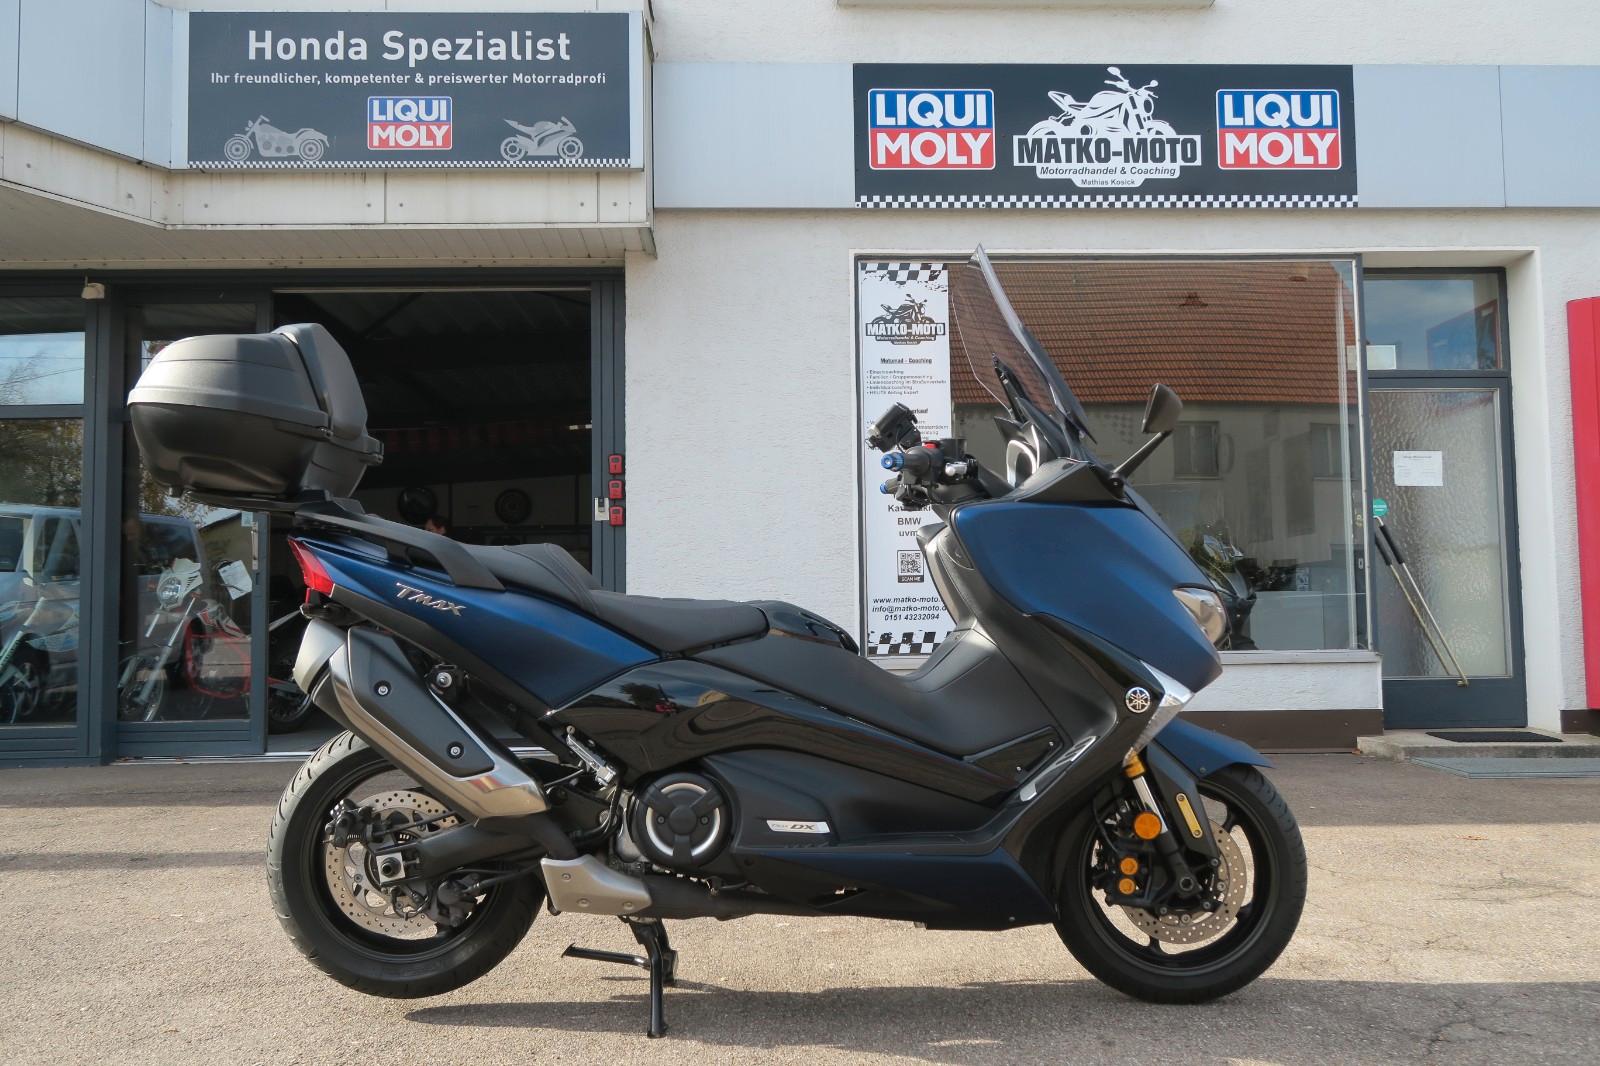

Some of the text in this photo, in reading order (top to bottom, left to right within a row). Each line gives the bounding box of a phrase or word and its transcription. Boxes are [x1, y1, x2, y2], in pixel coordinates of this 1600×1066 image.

[248, 30, 571, 67] Honda Spezialist
[211, 72, 606, 86] Ihr freundlicher, kompetenter & preiswerter Motorradprofi
[372, 99, 447, 123] LIQUI
[876, 93, 987, 129] LIQUI
[1224, 93, 1339, 129] LIQUI
[372, 125, 449, 147] MOLY
[877, 132, 991, 165] MOLY
[1017, 137, 1198, 165] MATKO-MOTO
[1226, 132, 1340, 165] MOLY
[1040, 166, 1177, 178] Motorradhandel & Coaching
[867, 323, 945, 336] MATKO-MOTO
[897, 517, 921, 525] BMW
[904, 613, 940, 621] 43232094
